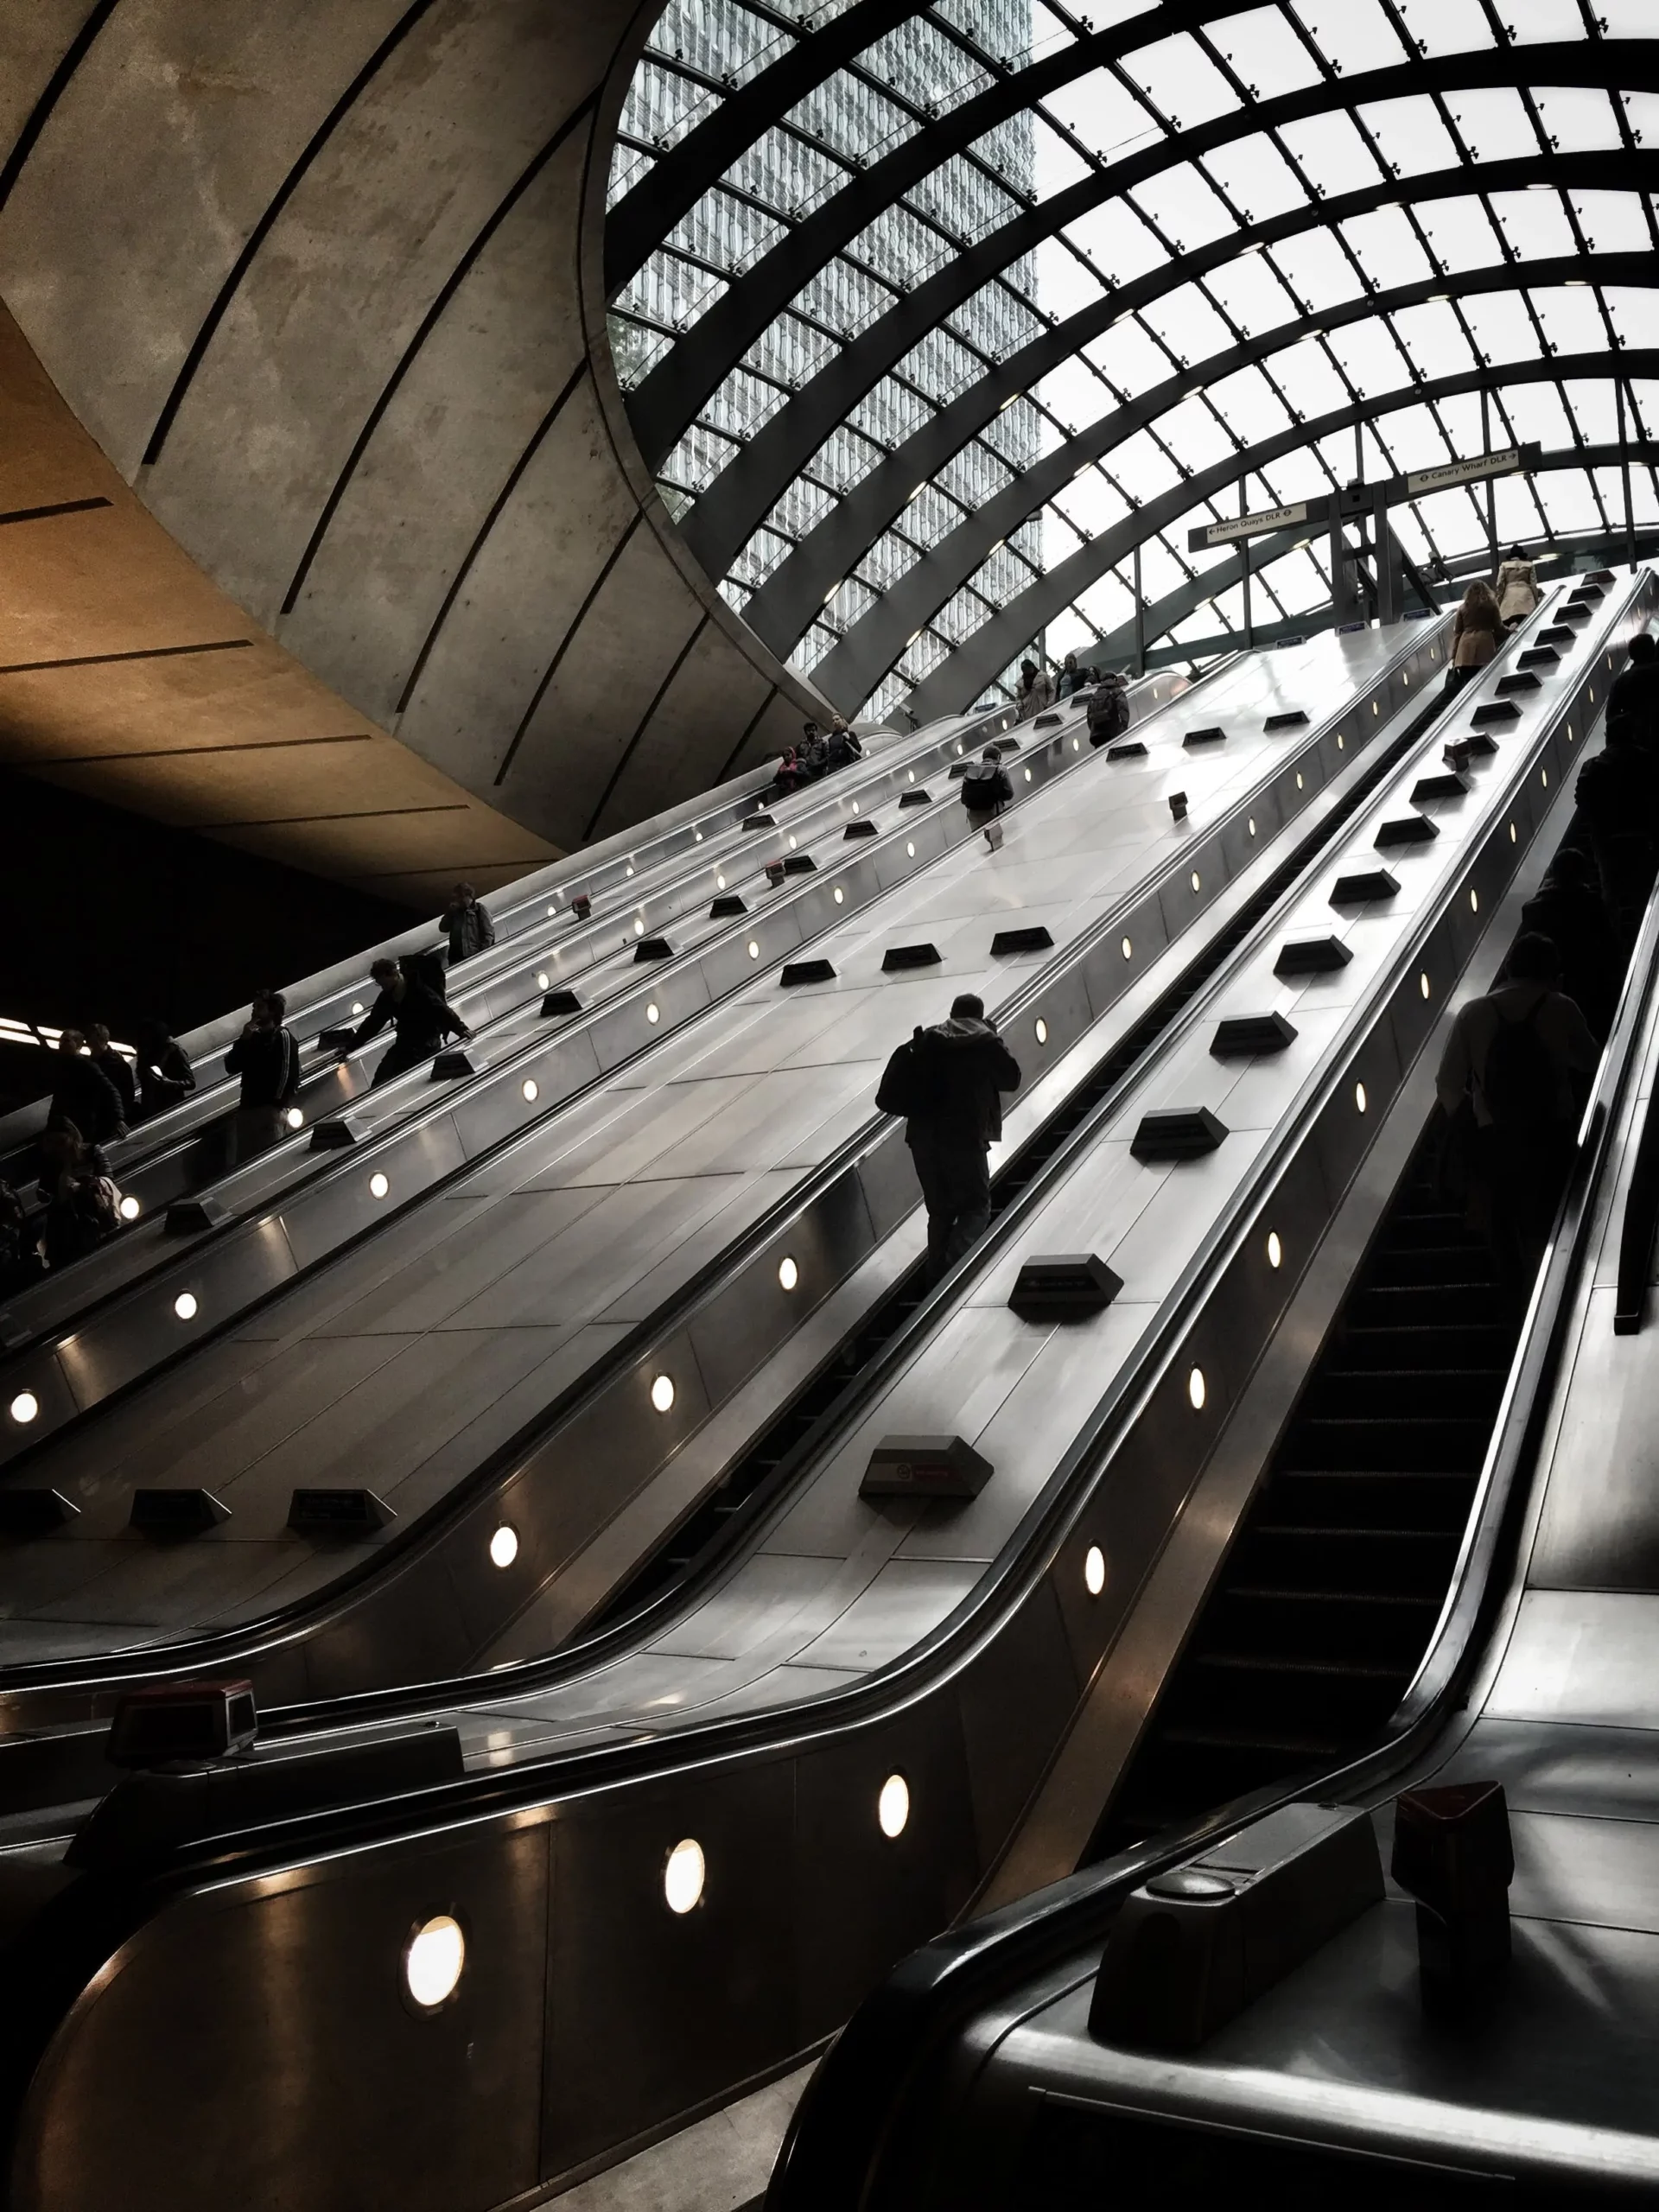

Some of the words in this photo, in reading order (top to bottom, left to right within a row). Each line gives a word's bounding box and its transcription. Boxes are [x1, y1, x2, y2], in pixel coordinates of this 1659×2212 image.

[1432, 467, 1459, 479] Canary
[1462, 460, 1487, 471] Wharf
[1491, 455, 1507, 465] DLR
[1217, 524, 1238, 533] Heron
[1241, 518, 1263, 527] Quays
[1266, 512, 1281, 521] DLR
